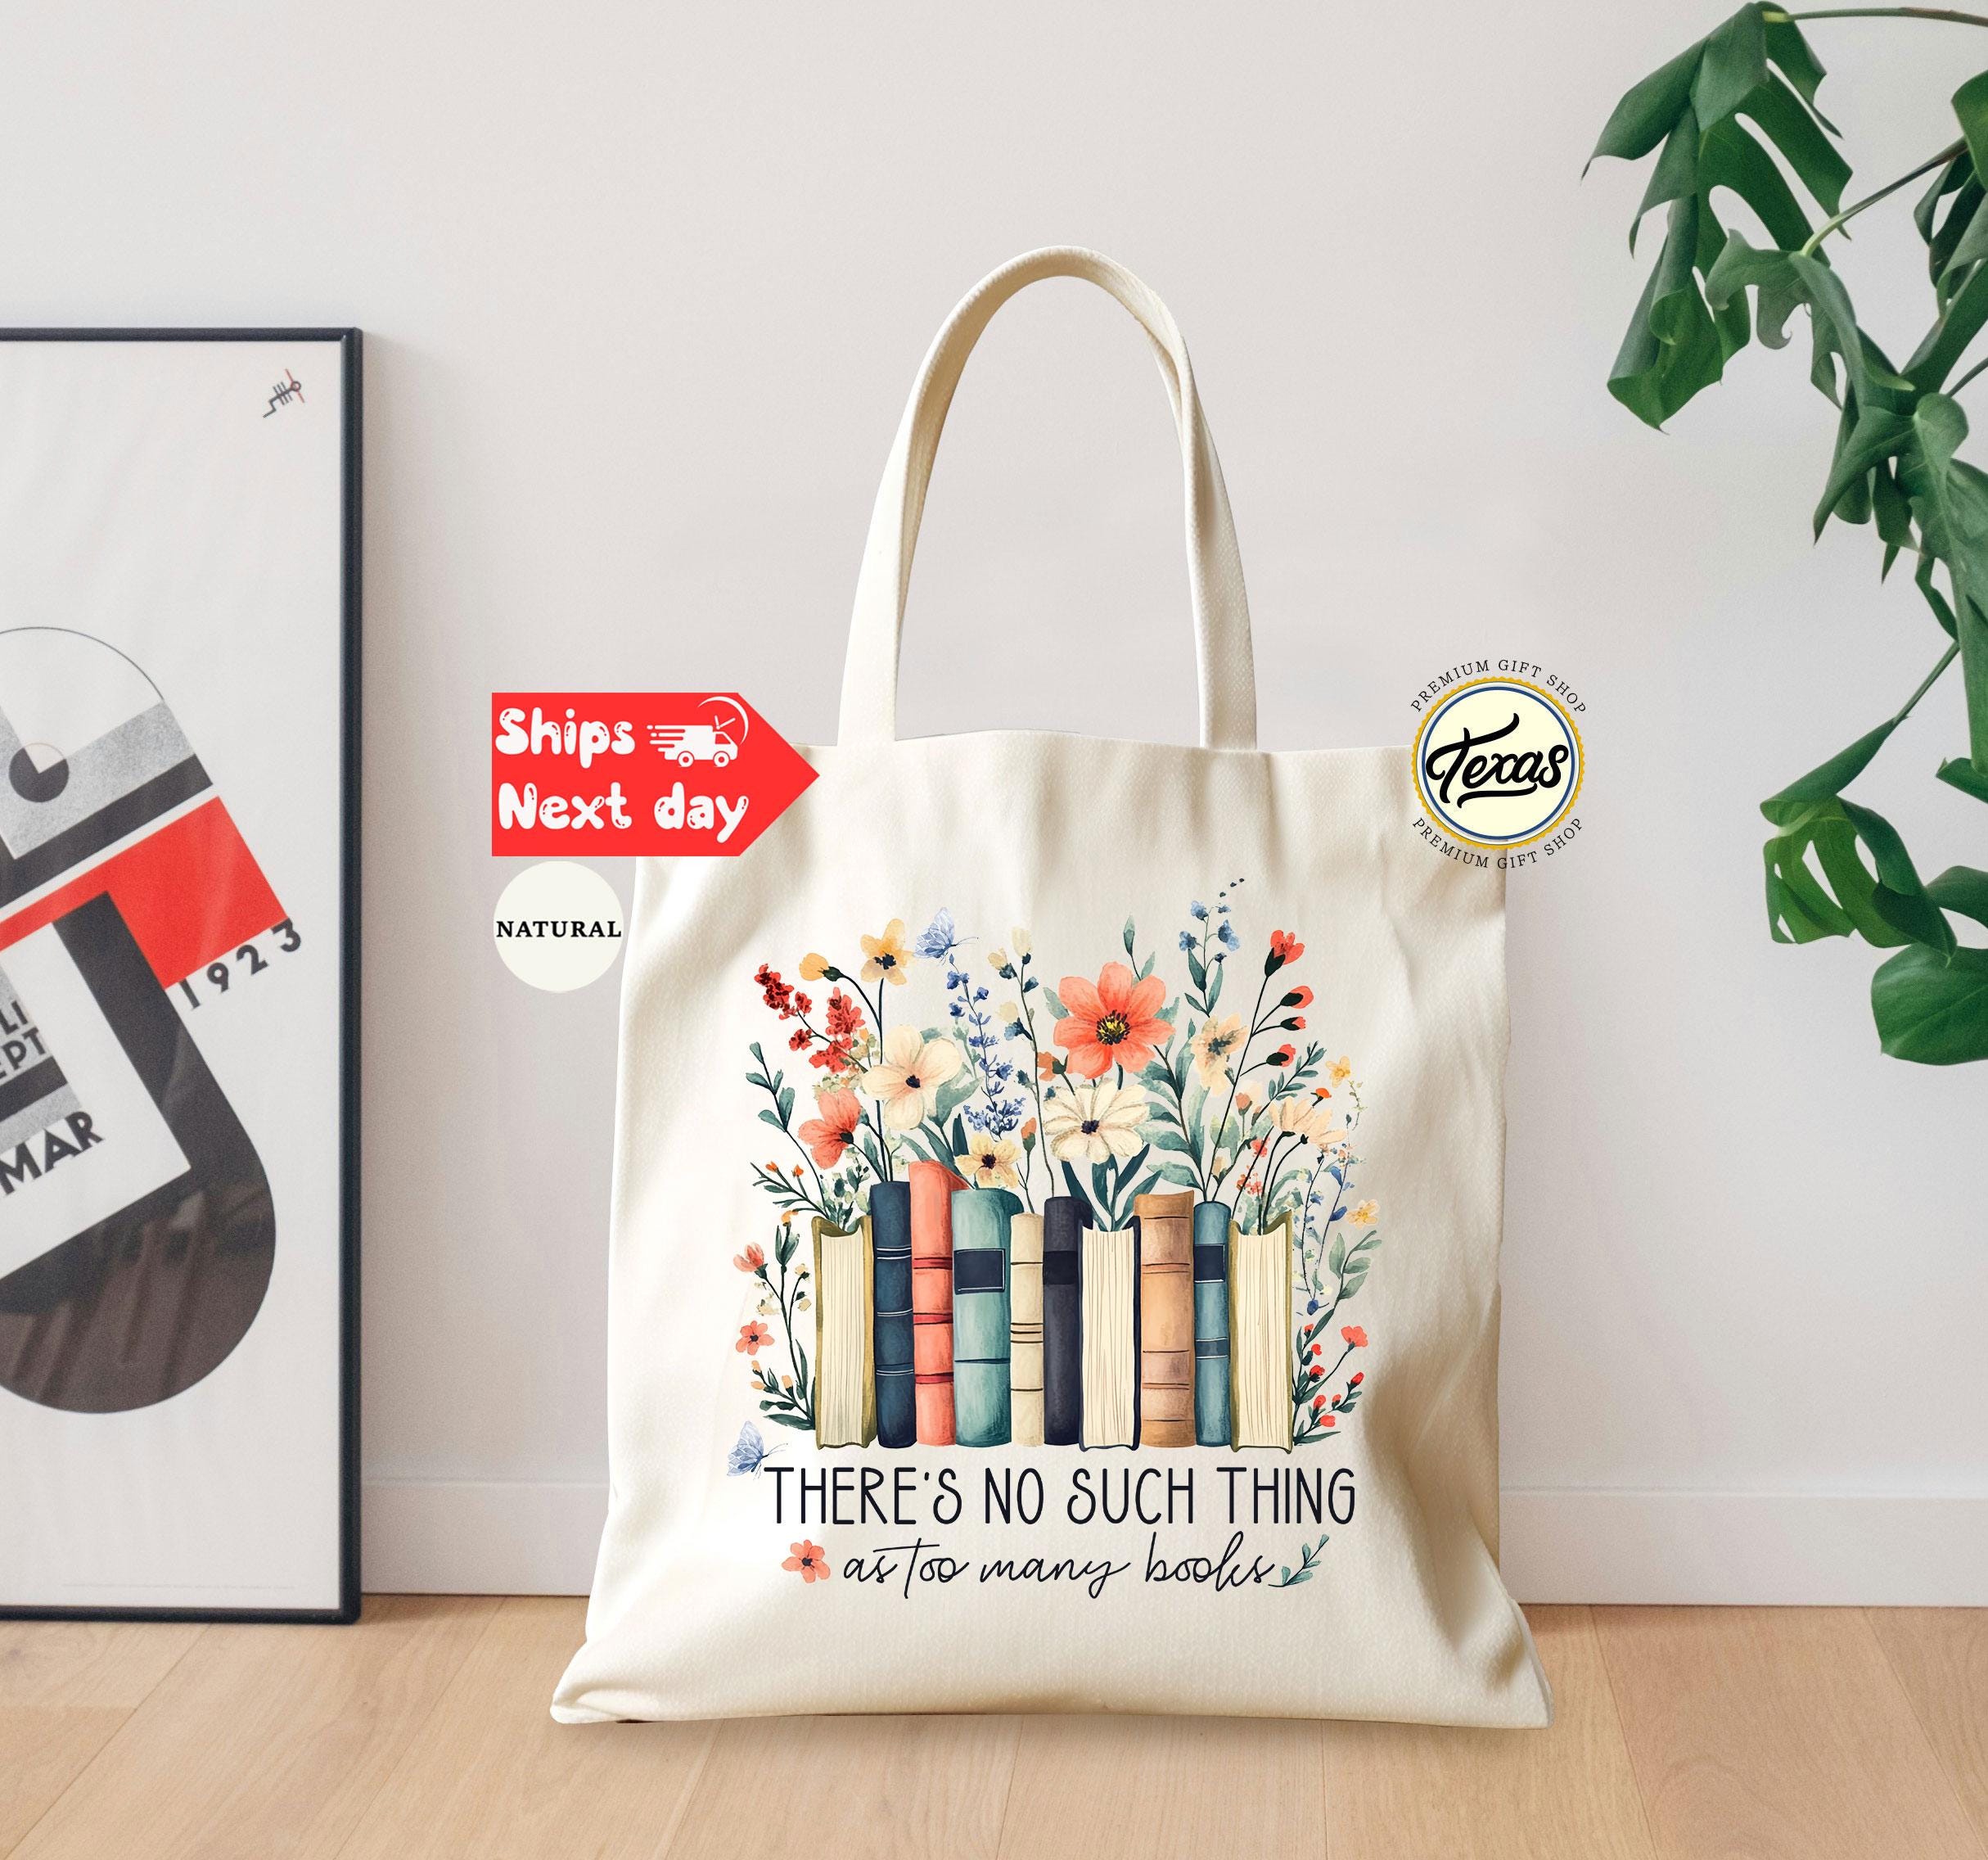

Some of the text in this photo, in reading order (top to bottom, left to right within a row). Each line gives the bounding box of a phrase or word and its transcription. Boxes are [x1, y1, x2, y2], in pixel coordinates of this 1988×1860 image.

[178, 918, 302, 1009] 1923
[0, 1026, 46, 1079] PT
[0, 1111, 105, 1196] MAR
[763, 1467, 1356, 1524] THERE'S NO SUCH THING
[843, 1555, 899, 1584] as
[980, 1557, 1131, 1599] many
[1145, 1530, 1276, 1592] books
